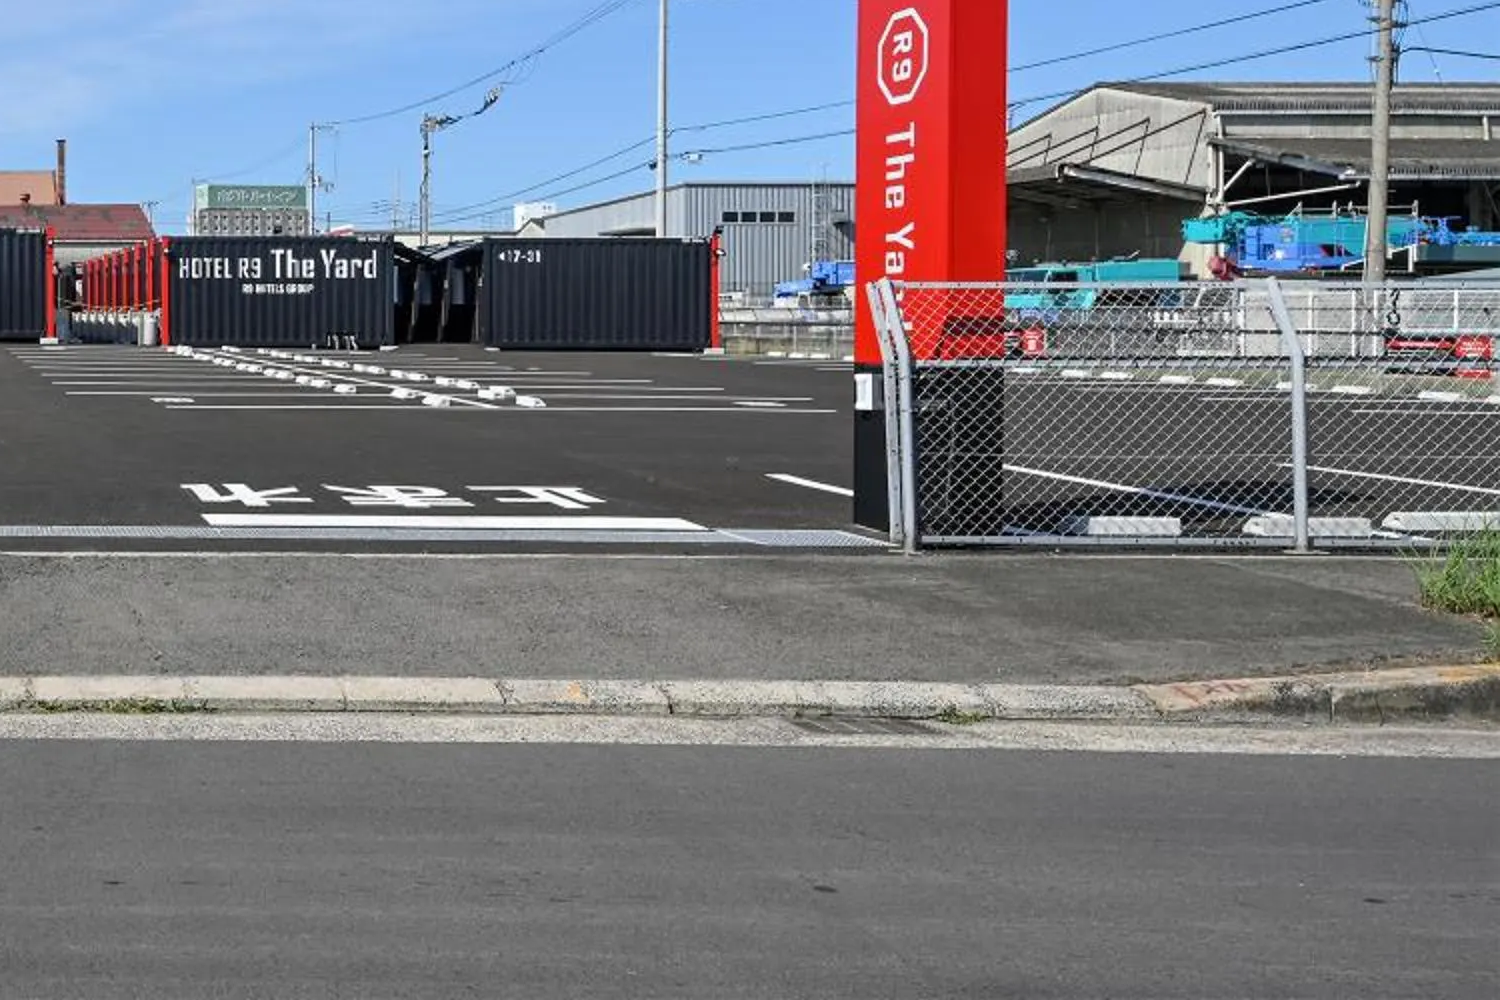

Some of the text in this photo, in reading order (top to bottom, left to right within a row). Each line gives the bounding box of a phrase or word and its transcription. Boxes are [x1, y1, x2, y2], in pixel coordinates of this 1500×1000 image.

[891, 30, 913, 82] R9
[885, 122, 915, 209] The
[179, 249, 377, 279] HOTEL R9 The Yard
[885, 221, 915, 332] Ya
[179, 483, 607, 509] 止まれ
